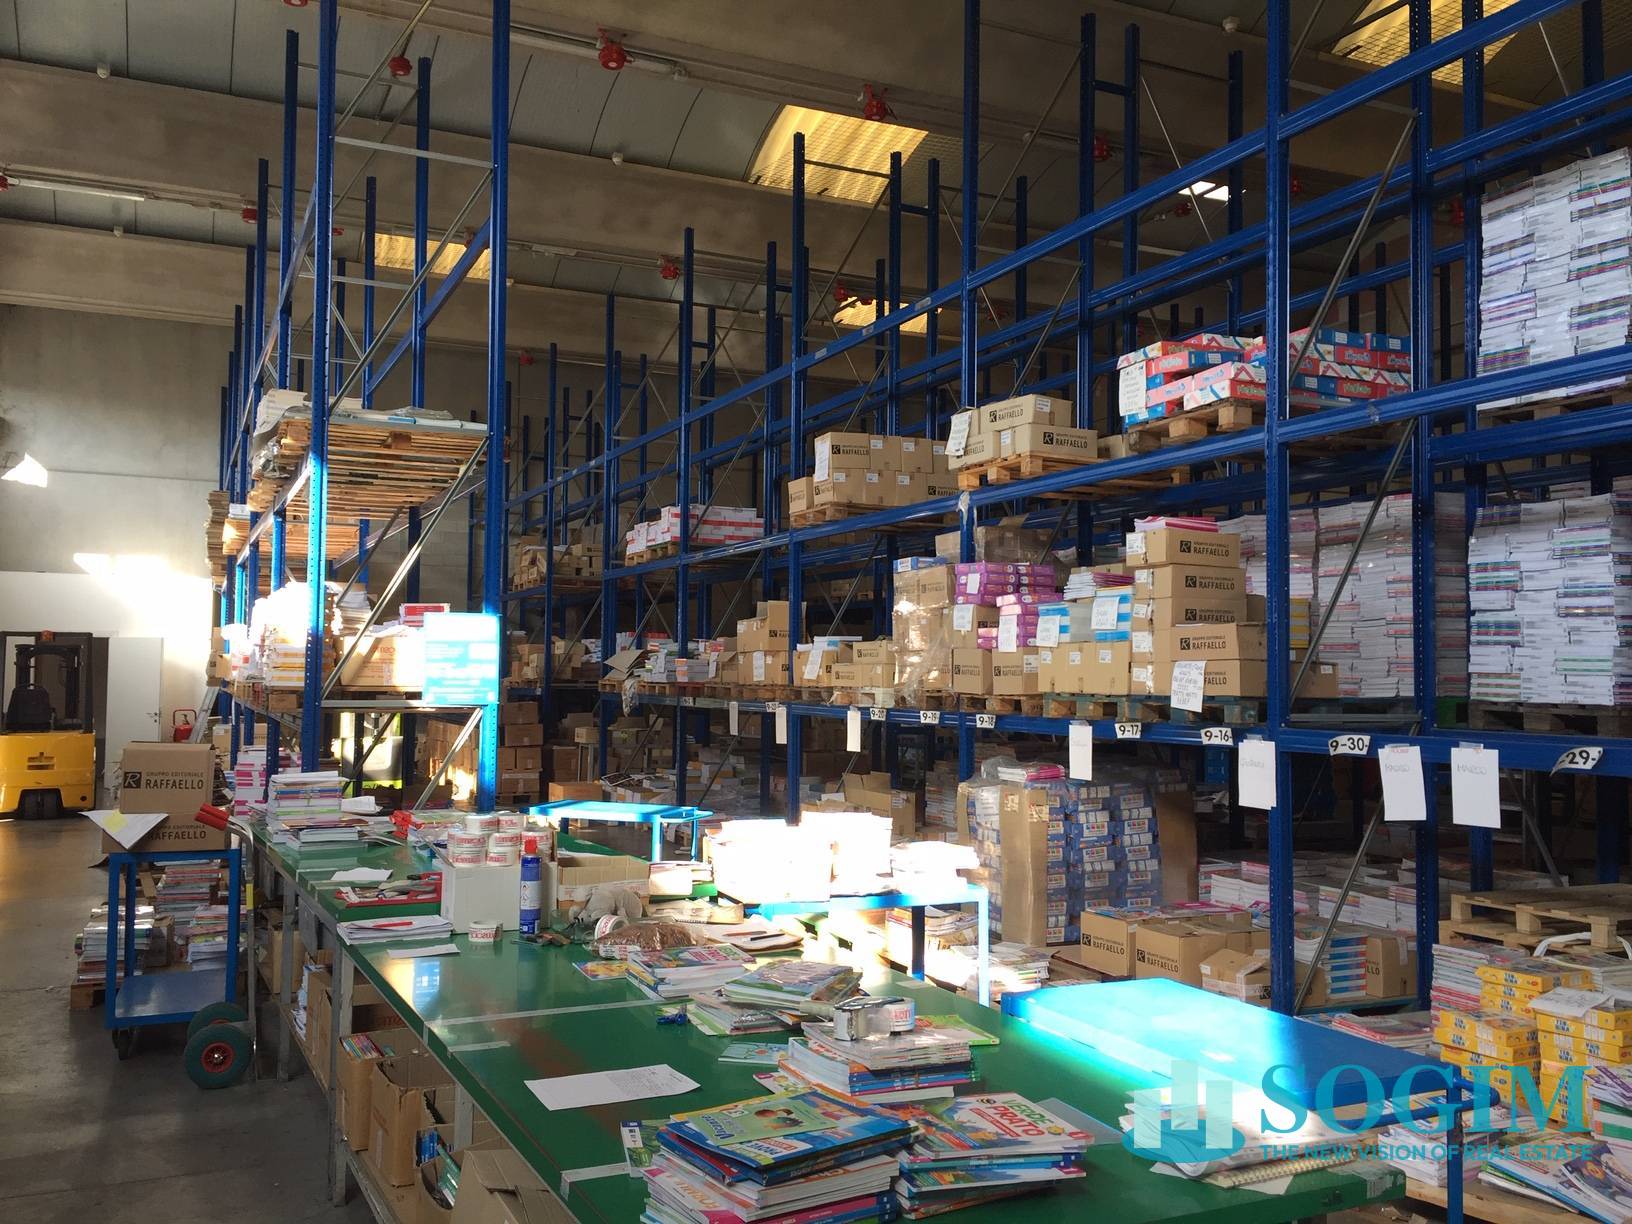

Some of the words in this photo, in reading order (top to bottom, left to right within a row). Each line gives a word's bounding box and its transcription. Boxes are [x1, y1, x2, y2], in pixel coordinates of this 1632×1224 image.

[1055, 438, 1088, 449] RAFFAELLO
[1180, 541, 1191, 553] R
[1193, 547, 1230, 558] RAFFAELLO
[1185, 576, 1197, 588] R
[1199, 581, 1235, 591] RAFFAELLO
[1198, 614, 1235, 623] RAFFAELLO
[1180, 637, 1190, 650] R
[1192, 641, 1226, 650] RAFFAELLO
[1205, 676, 1227, 685] FAELLO
[124, 772, 142, 788] R
[145, 779, 204, 790] RAFFAELLO
[1093, 940, 1124, 955] RAFFAELLO
[1147, 957, 1179, 973] RAFFAELLO
[1001, 1099, 1054, 1125] VERDE
[987, 1105, 1045, 1137] PRATO
